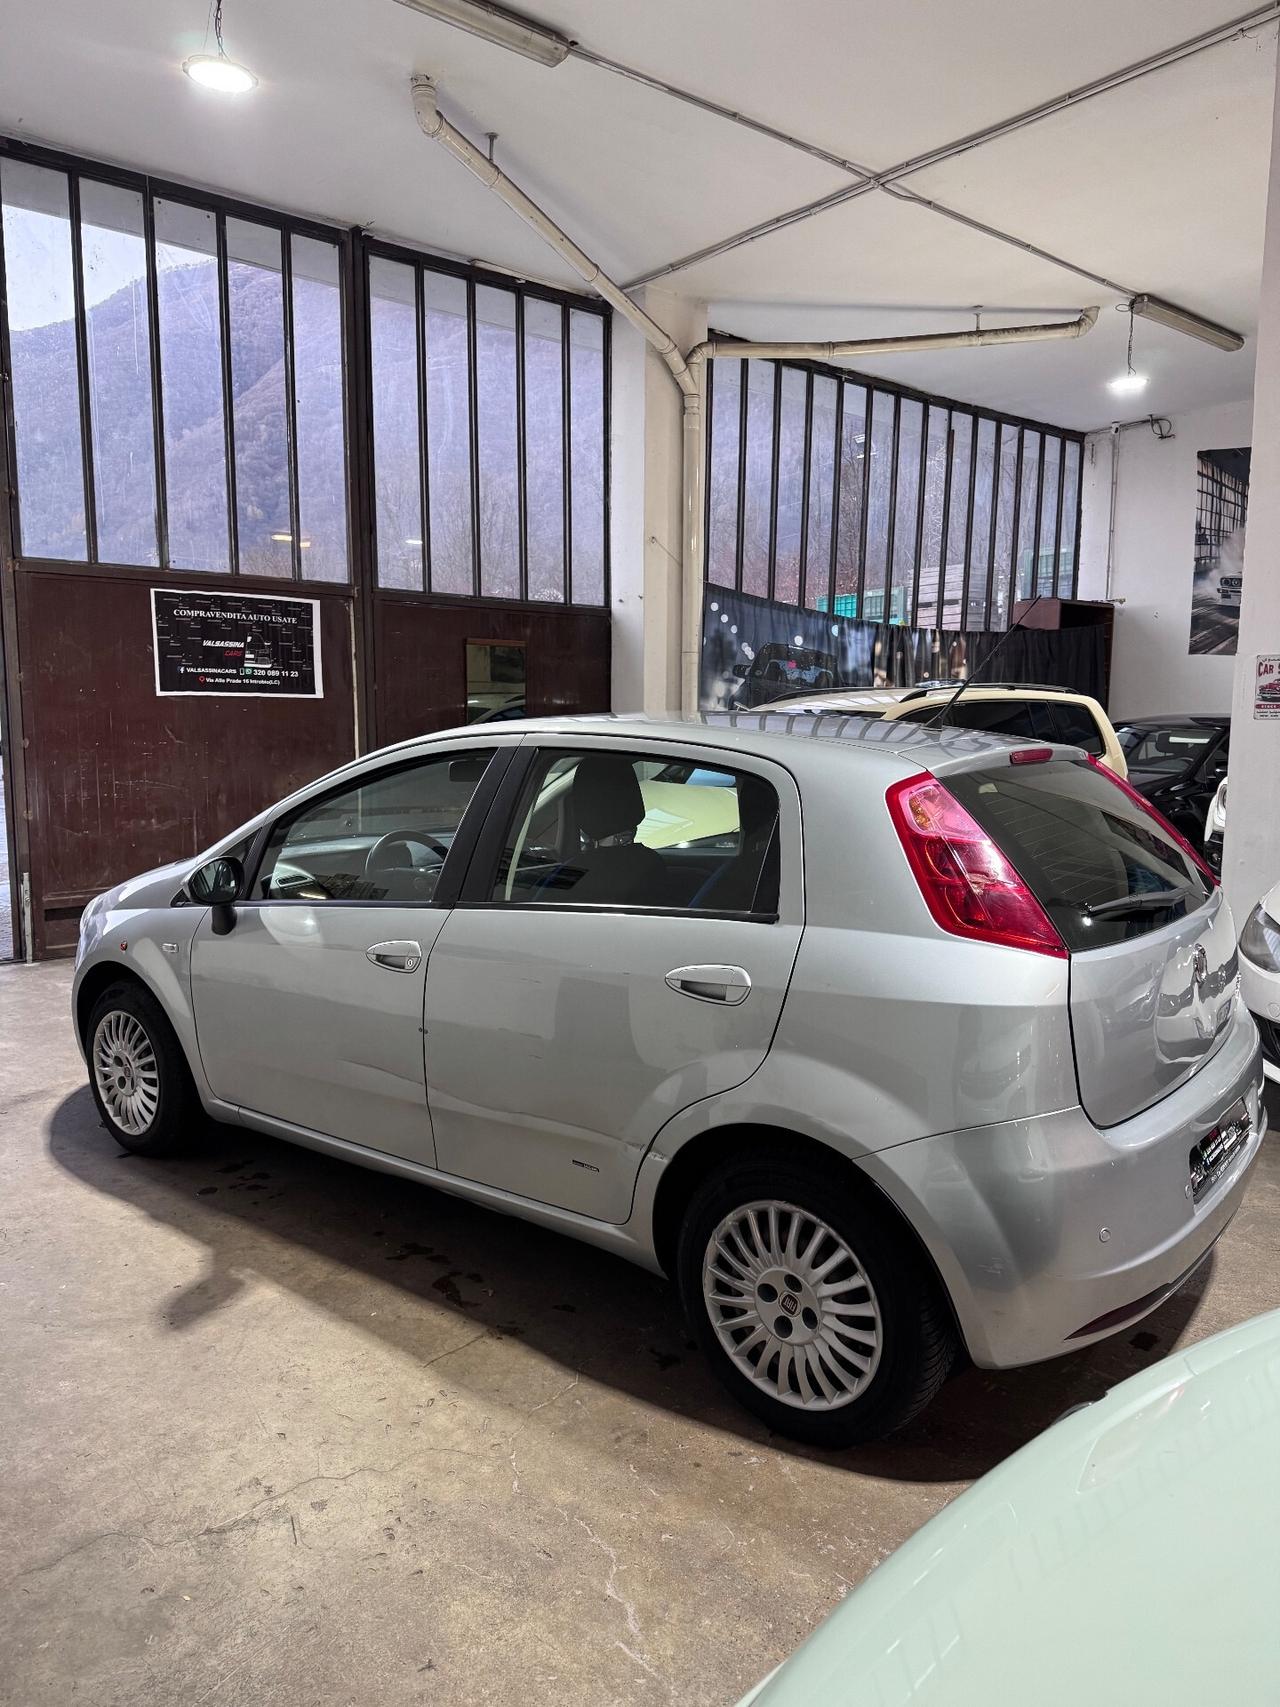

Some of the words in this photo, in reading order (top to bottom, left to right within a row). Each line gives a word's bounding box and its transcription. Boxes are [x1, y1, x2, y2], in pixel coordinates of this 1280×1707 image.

[173, 609, 247, 620] COMPRAVENDITA
[272, 616, 298, 624] USATE
[202, 640, 244, 648] VALSASSINA
[1258, 661, 1274, 677] CAR
